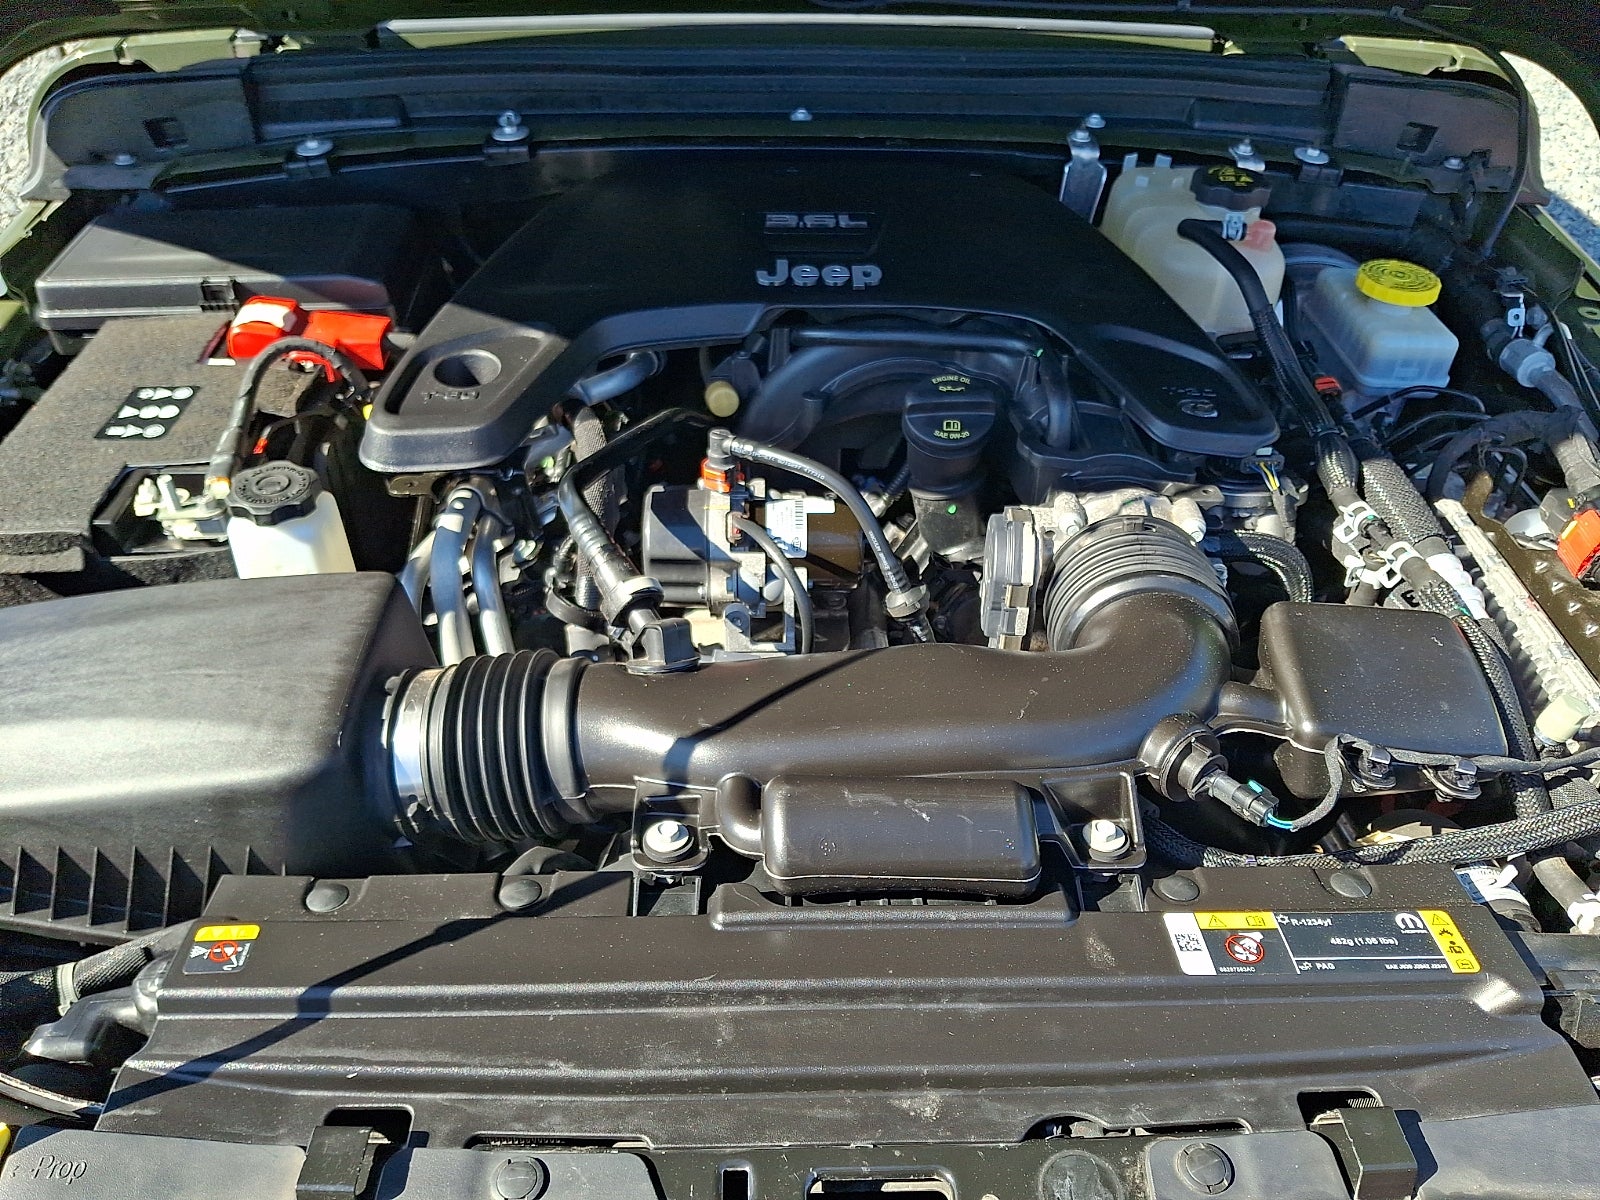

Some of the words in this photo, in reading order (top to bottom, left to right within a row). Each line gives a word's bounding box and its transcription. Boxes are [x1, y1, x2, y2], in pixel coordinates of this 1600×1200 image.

[756, 259, 883, 290] Jeep
[931, 375, 959, 385] ENGINE
[960, 376, 972, 385] OIL
[933, 430, 948, 439] SAE
[949, 430, 970, 440] 0W-20
[1330, 936, 1354, 947] 482g
[1315, 962, 1336, 970] PAG
[32, 1154, 88, 1186] Prop
